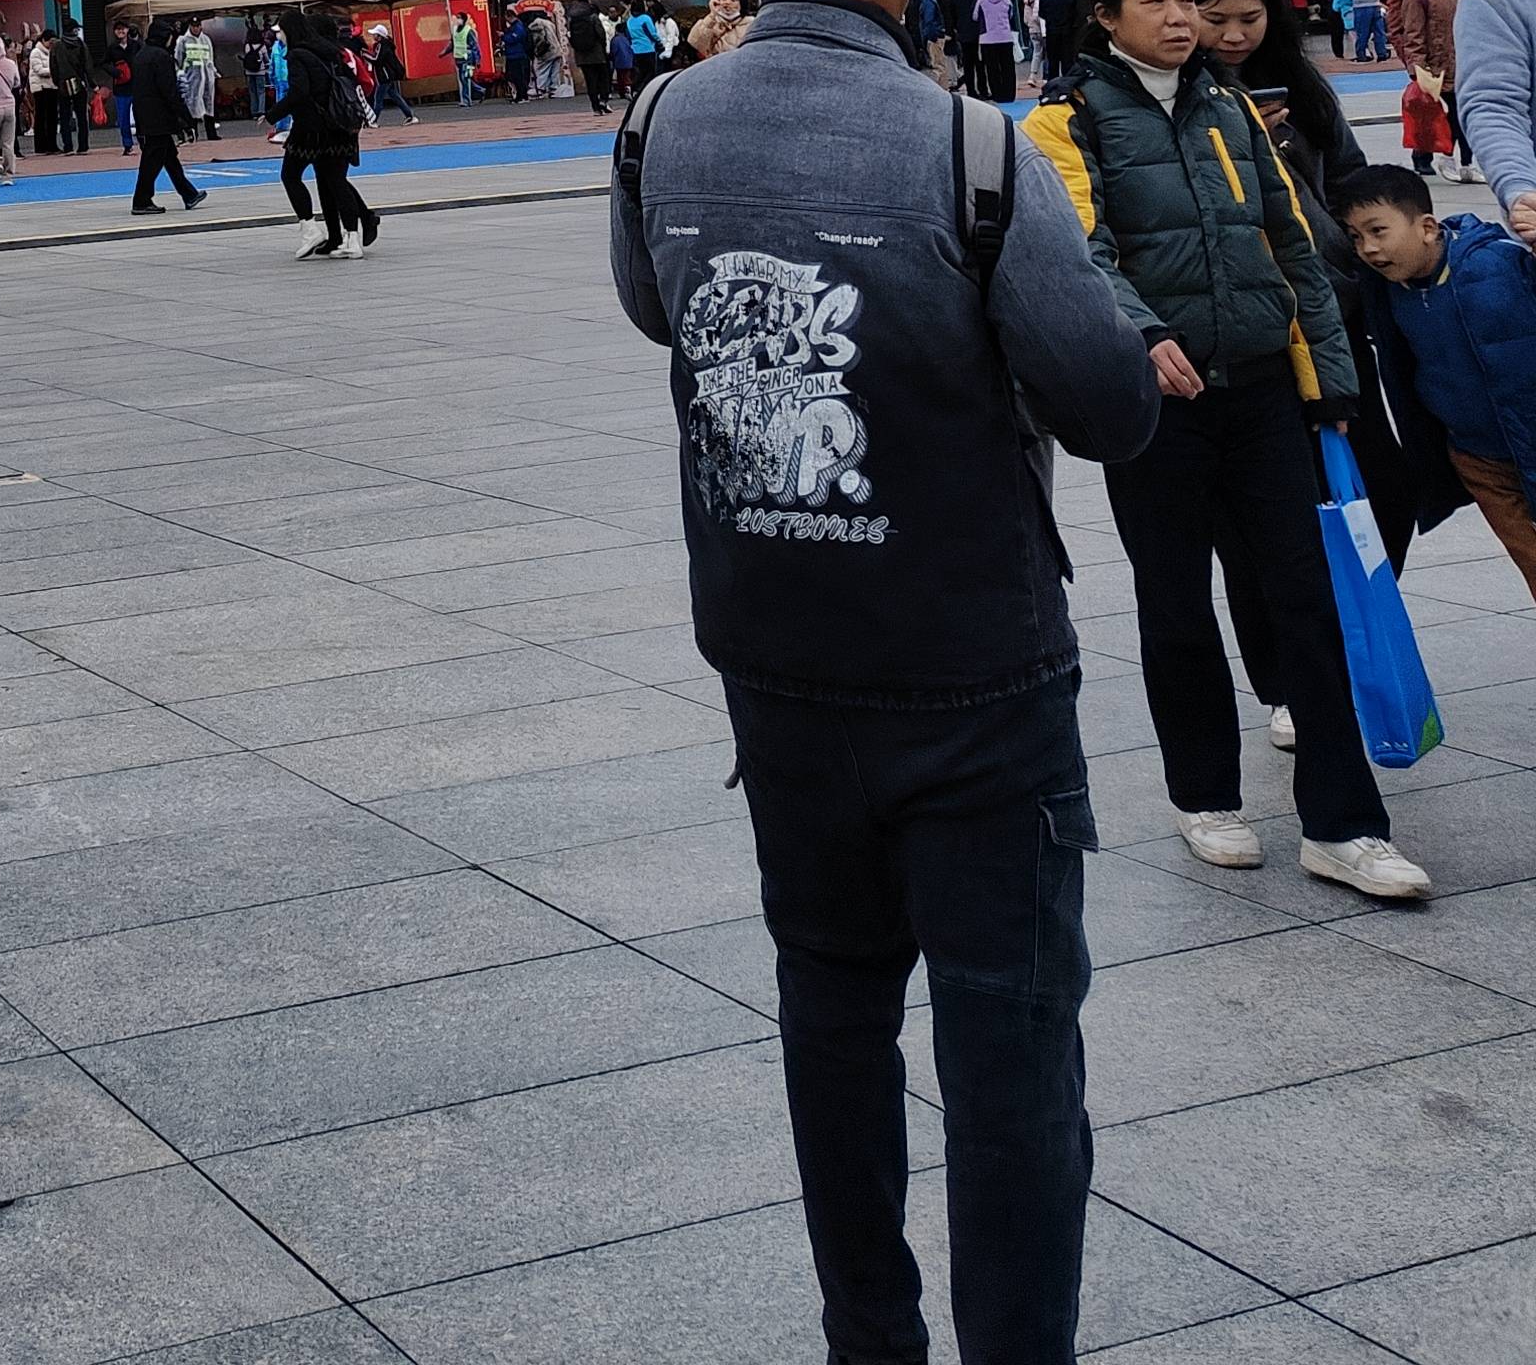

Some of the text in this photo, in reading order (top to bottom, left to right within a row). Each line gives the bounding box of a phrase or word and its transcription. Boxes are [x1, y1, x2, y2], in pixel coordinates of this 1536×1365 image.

[779, 266, 805, 289] MY
[804, 378, 826, 394] ON
[827, 376, 839, 393] A
